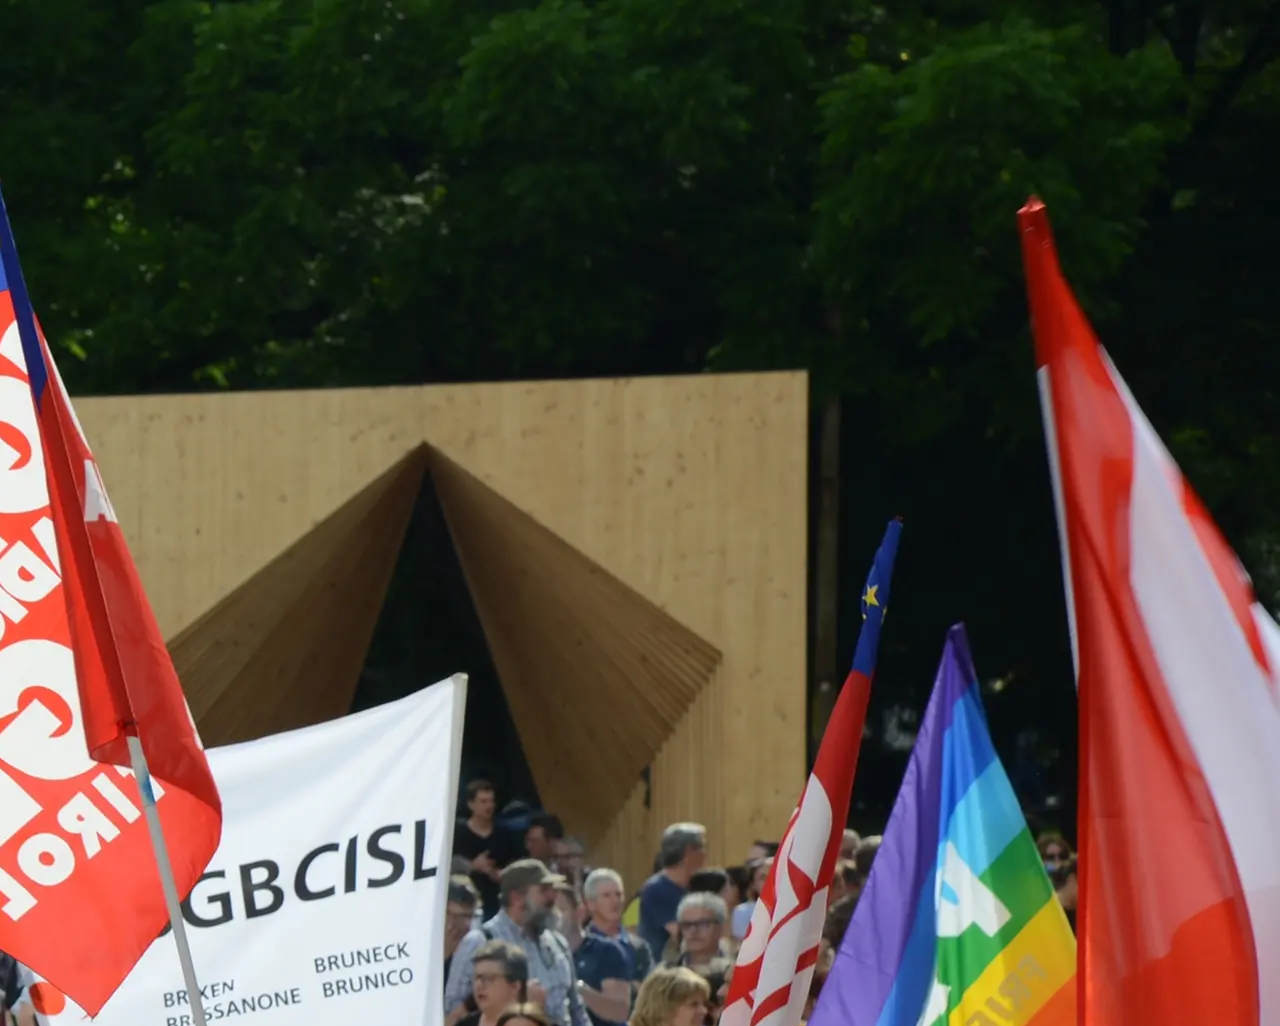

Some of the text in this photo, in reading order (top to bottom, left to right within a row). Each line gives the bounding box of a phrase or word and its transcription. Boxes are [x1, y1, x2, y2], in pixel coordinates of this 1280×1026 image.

[158, 817, 438, 937] GBCISL
[314, 941, 410, 974] BRUNECK
[163, 979, 235, 1007] BRXEN
[322, 967, 414, 998] BRUNICO
